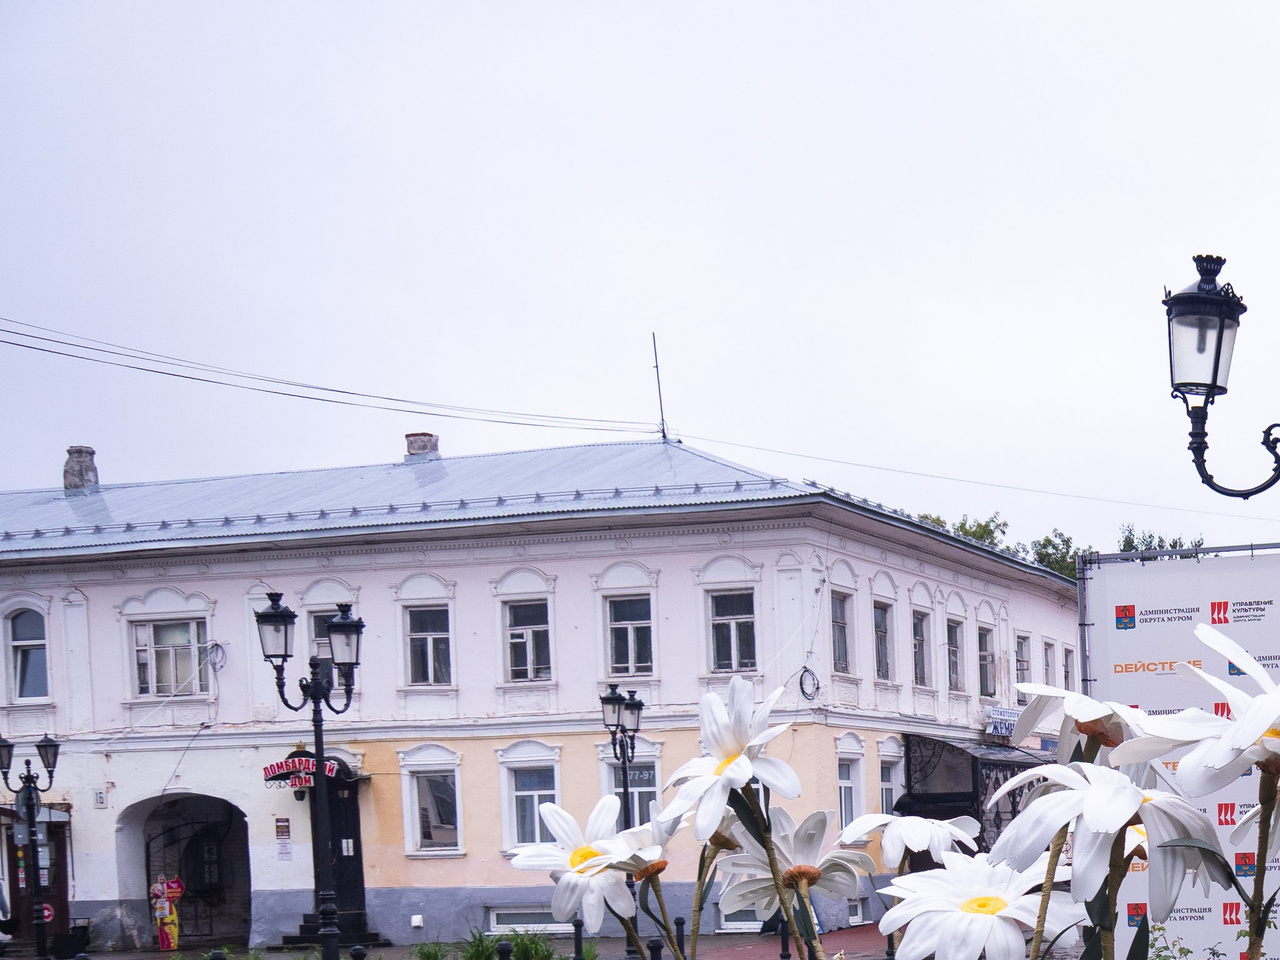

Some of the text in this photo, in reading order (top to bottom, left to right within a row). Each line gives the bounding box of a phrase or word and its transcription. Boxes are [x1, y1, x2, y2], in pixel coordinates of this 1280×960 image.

[1139, 607, 1200, 617] АДМИНИСТРАЦИЯ
[1139, 615, 1193, 624] ОКРУГА МУРОМ
[290, 774, 312, 788] ДОМ
[96, 792, 104, 804] 16
